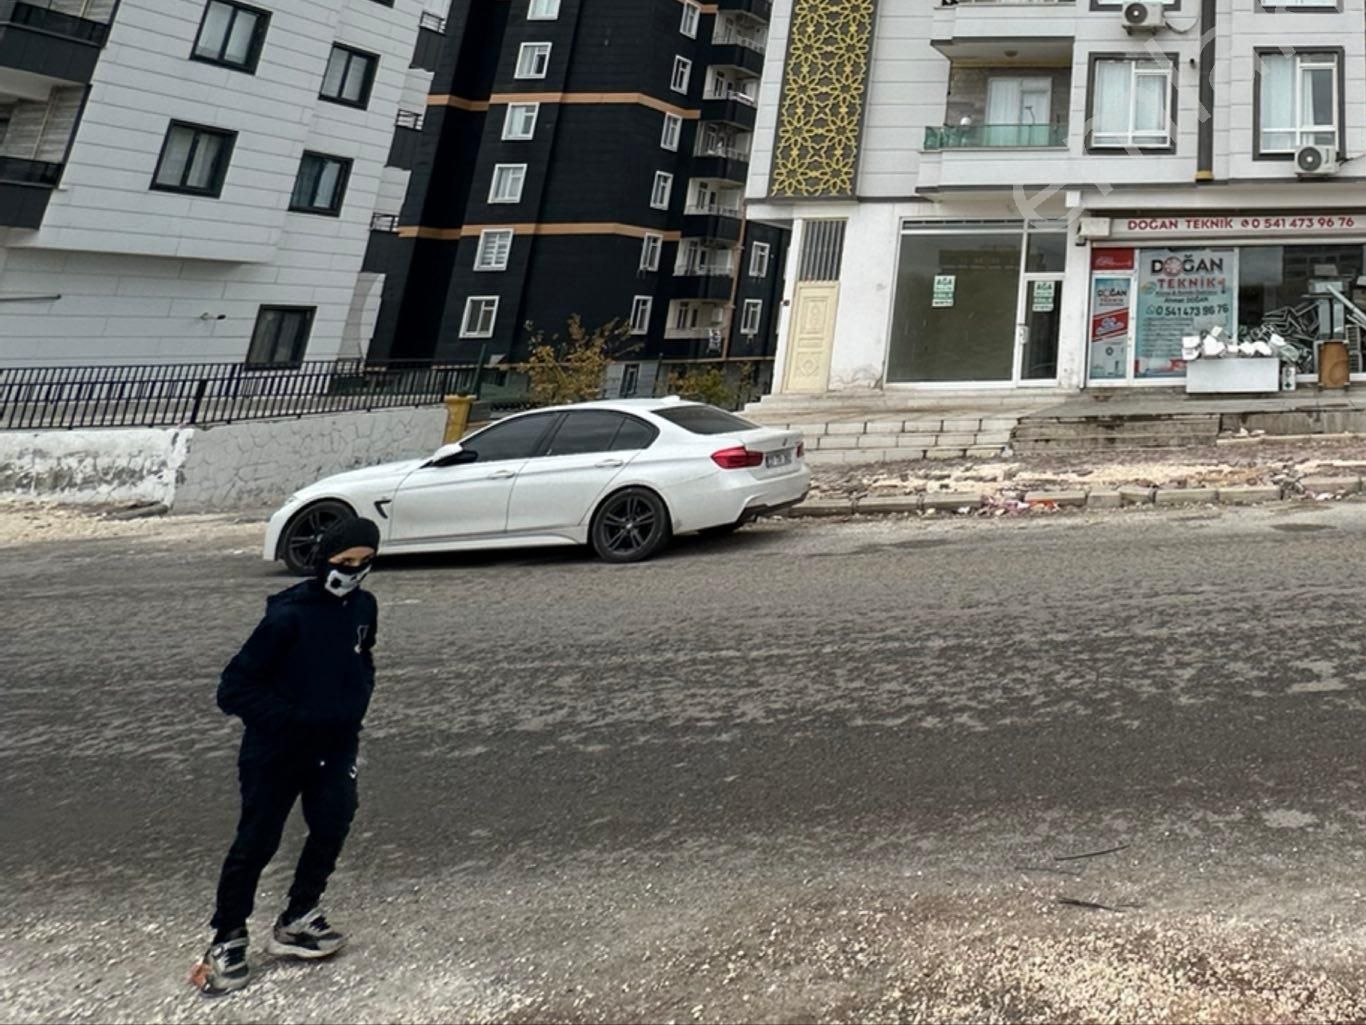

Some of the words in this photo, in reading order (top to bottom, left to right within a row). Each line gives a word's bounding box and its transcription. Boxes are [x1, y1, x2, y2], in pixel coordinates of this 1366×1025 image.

[1251, 217, 1261, 229] 0
[1264, 217, 1286, 229] 541
[1290, 216, 1314, 228] 473
[1318, 216, 1335, 228] 96
[1338, 215, 1355, 227] 76
[1165, 306, 1182, 317] 541
[1183, 306, 1201, 317] 473
